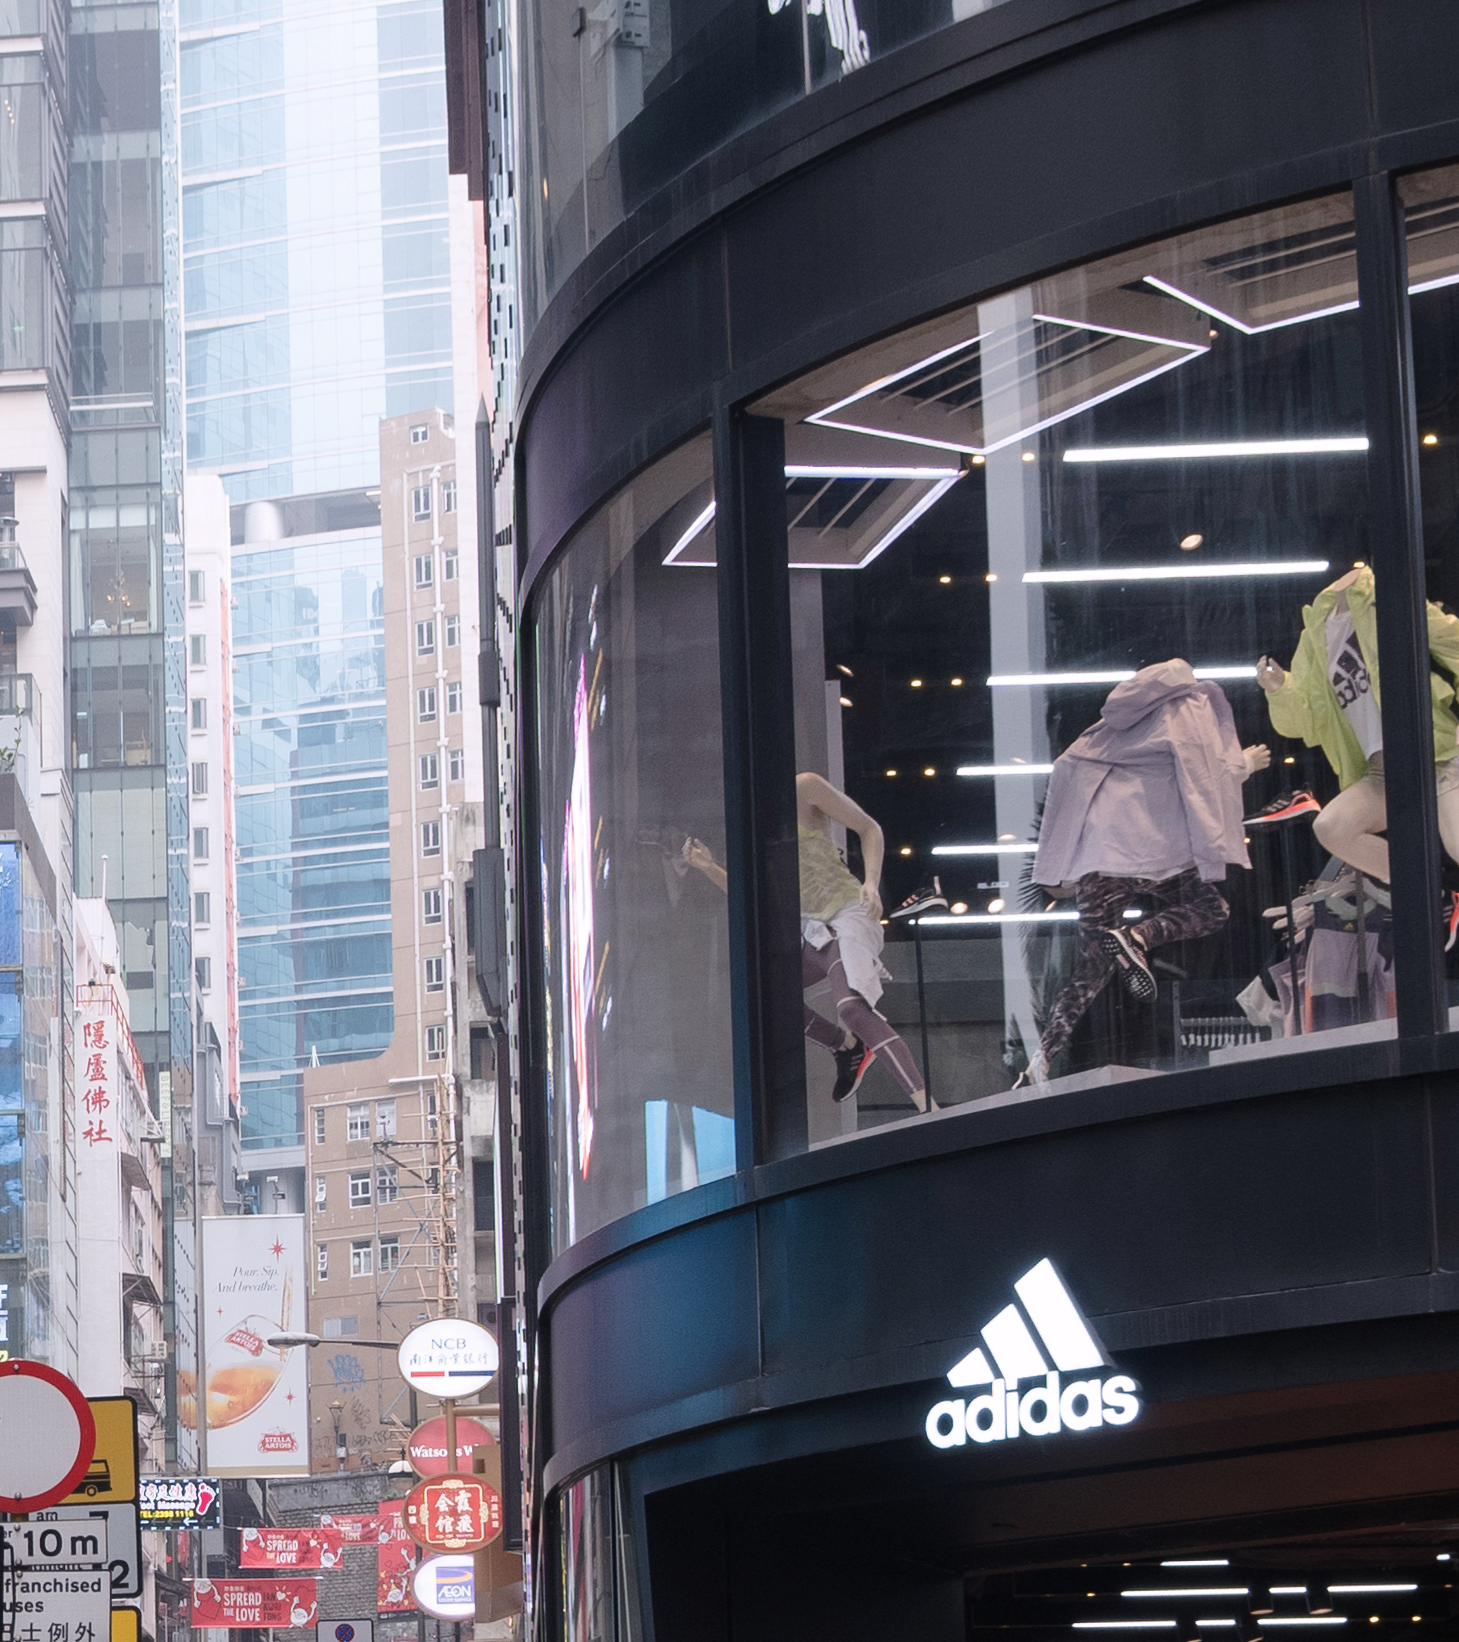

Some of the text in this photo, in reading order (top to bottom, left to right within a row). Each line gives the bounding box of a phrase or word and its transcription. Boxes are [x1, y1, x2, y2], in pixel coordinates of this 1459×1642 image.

[431, 1338, 467, 1350] NCB
[924, 1368, 1142, 1450] adidas
[409, 1444, 463, 1458] Watsos
[23, 1528, 99, 1558] 10 m
[266, 1538, 299, 1551] SPREAD
[275, 1552, 297, 1564] LOVE
[107, 1559, 130, 1589] 2
[4, 1577, 102, 1593] franchised
[222, 1592, 262, 1606] SPREAD
[3, 1600, 45, 1613] uses
[235, 1607, 261, 1622] LOVE
